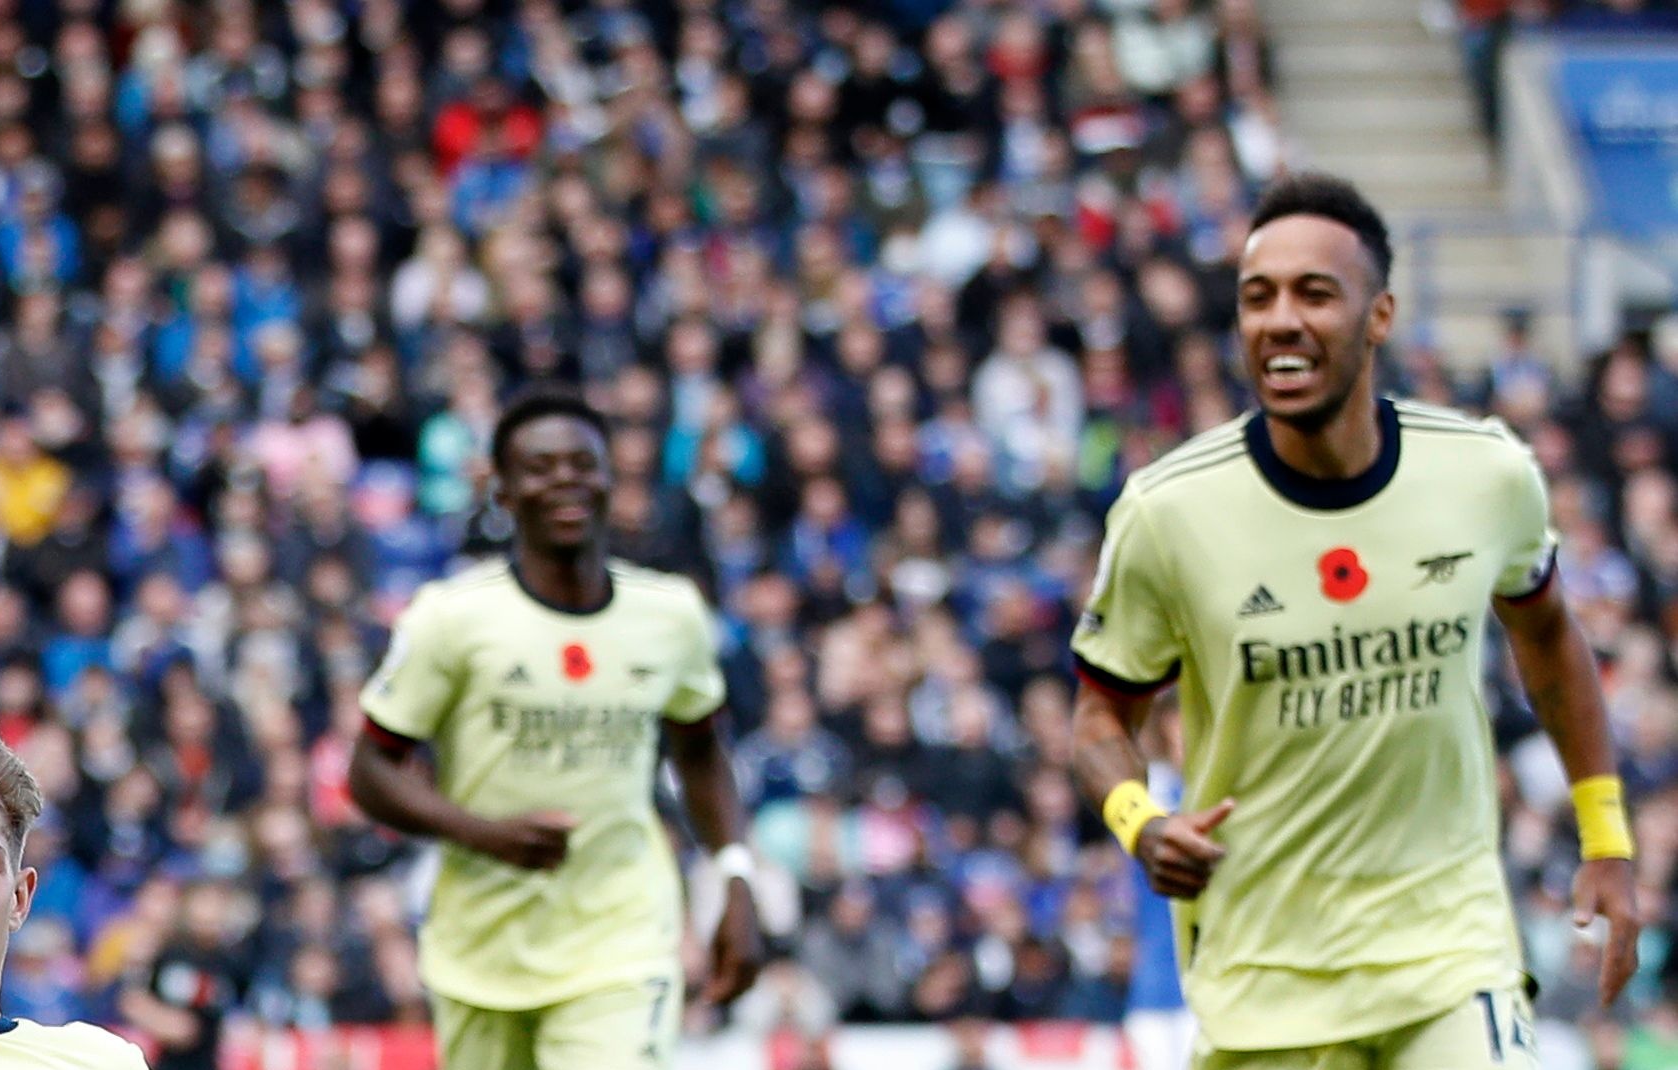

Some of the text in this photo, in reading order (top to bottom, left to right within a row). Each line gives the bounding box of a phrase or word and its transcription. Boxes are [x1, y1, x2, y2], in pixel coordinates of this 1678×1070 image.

[1238, 616, 1470, 684] Emirates
[1277, 667, 1443, 728] FLY BETTER
